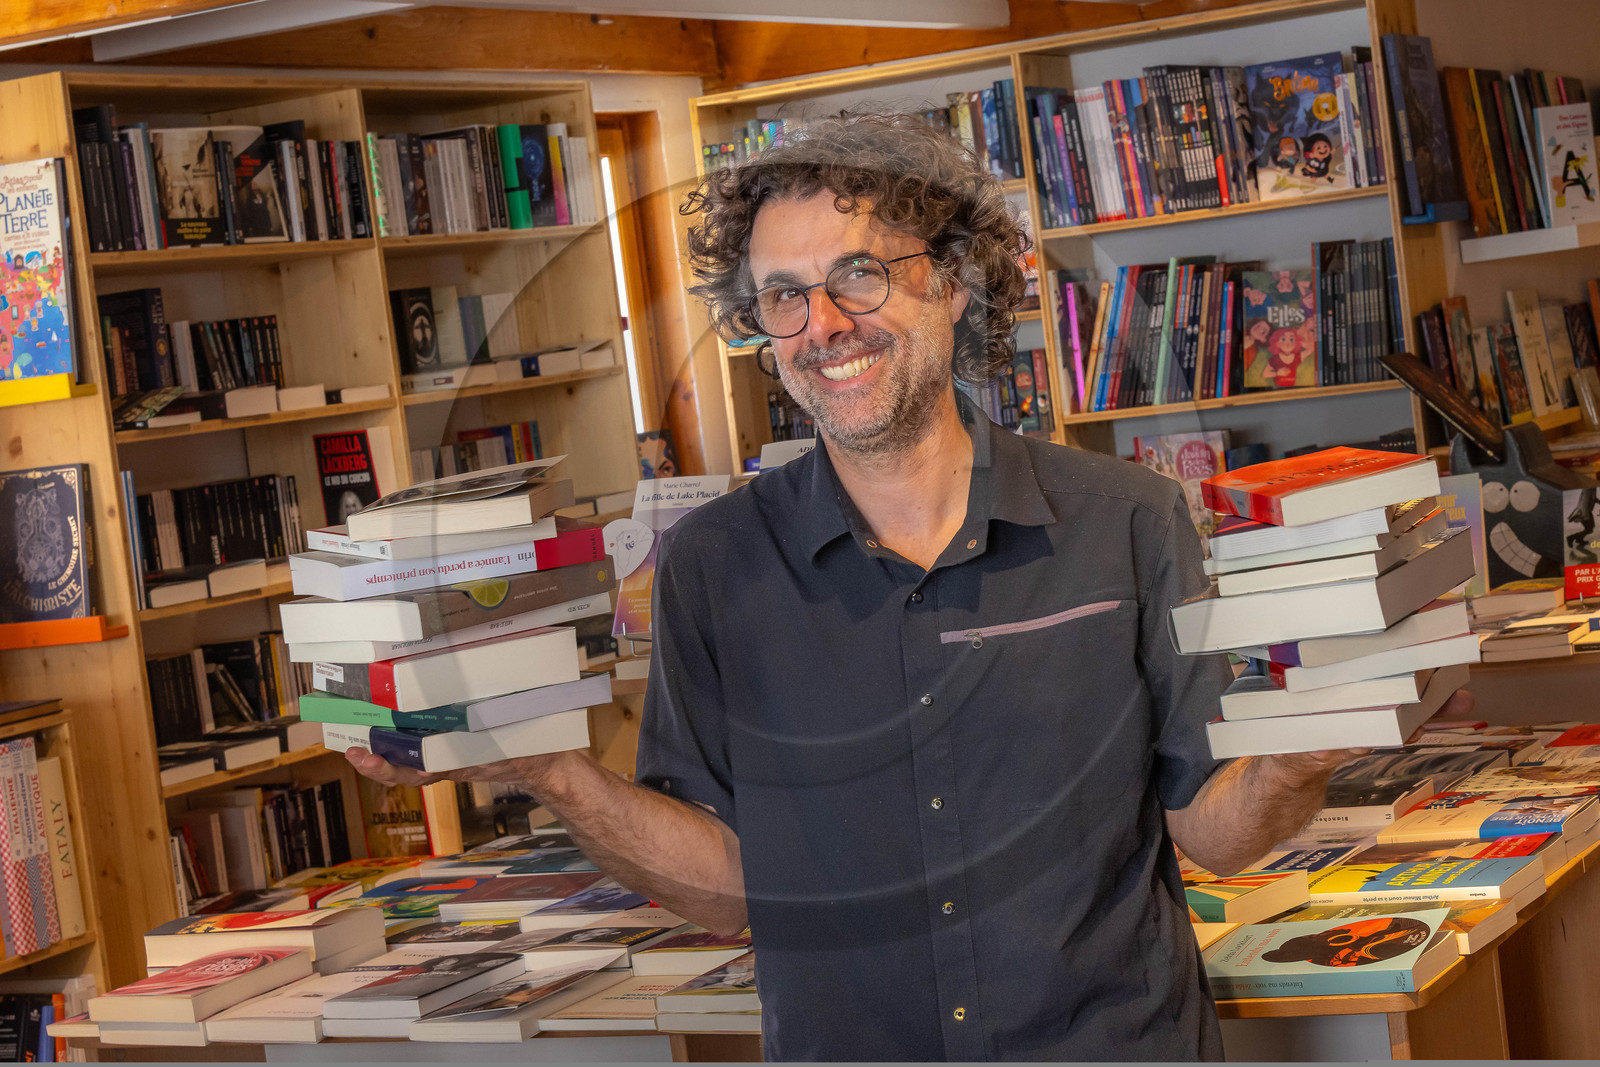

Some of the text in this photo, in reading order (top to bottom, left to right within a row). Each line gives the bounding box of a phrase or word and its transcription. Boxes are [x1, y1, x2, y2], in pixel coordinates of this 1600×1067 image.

[321, 435, 362, 455] CAMILLA
[651, 493, 664, 501] fille
[676, 491, 695, 499] Lake
[696, 490, 720, 498] Placid
[365, 567, 417, 585] printemps
[419, 566, 436, 576] son
[437, 559, 467, 577] perdu
[1575, 568, 1590, 576] PAR
[1577, 575, 1595, 583] PRIX
[7, 778, 20, 835] ITALIENNE
[31, 773, 46, 838] ASIATIQUE
[1514, 816, 1561, 826] BENOÎT
[50, 799, 73, 879] EATALY
[1386, 862, 1440, 886] ARTHUR
[1411, 861, 1465, 886] MINEUR
[1234, 946, 1264, 968] Entends
[1278, 981, 1304, 989] Entends
